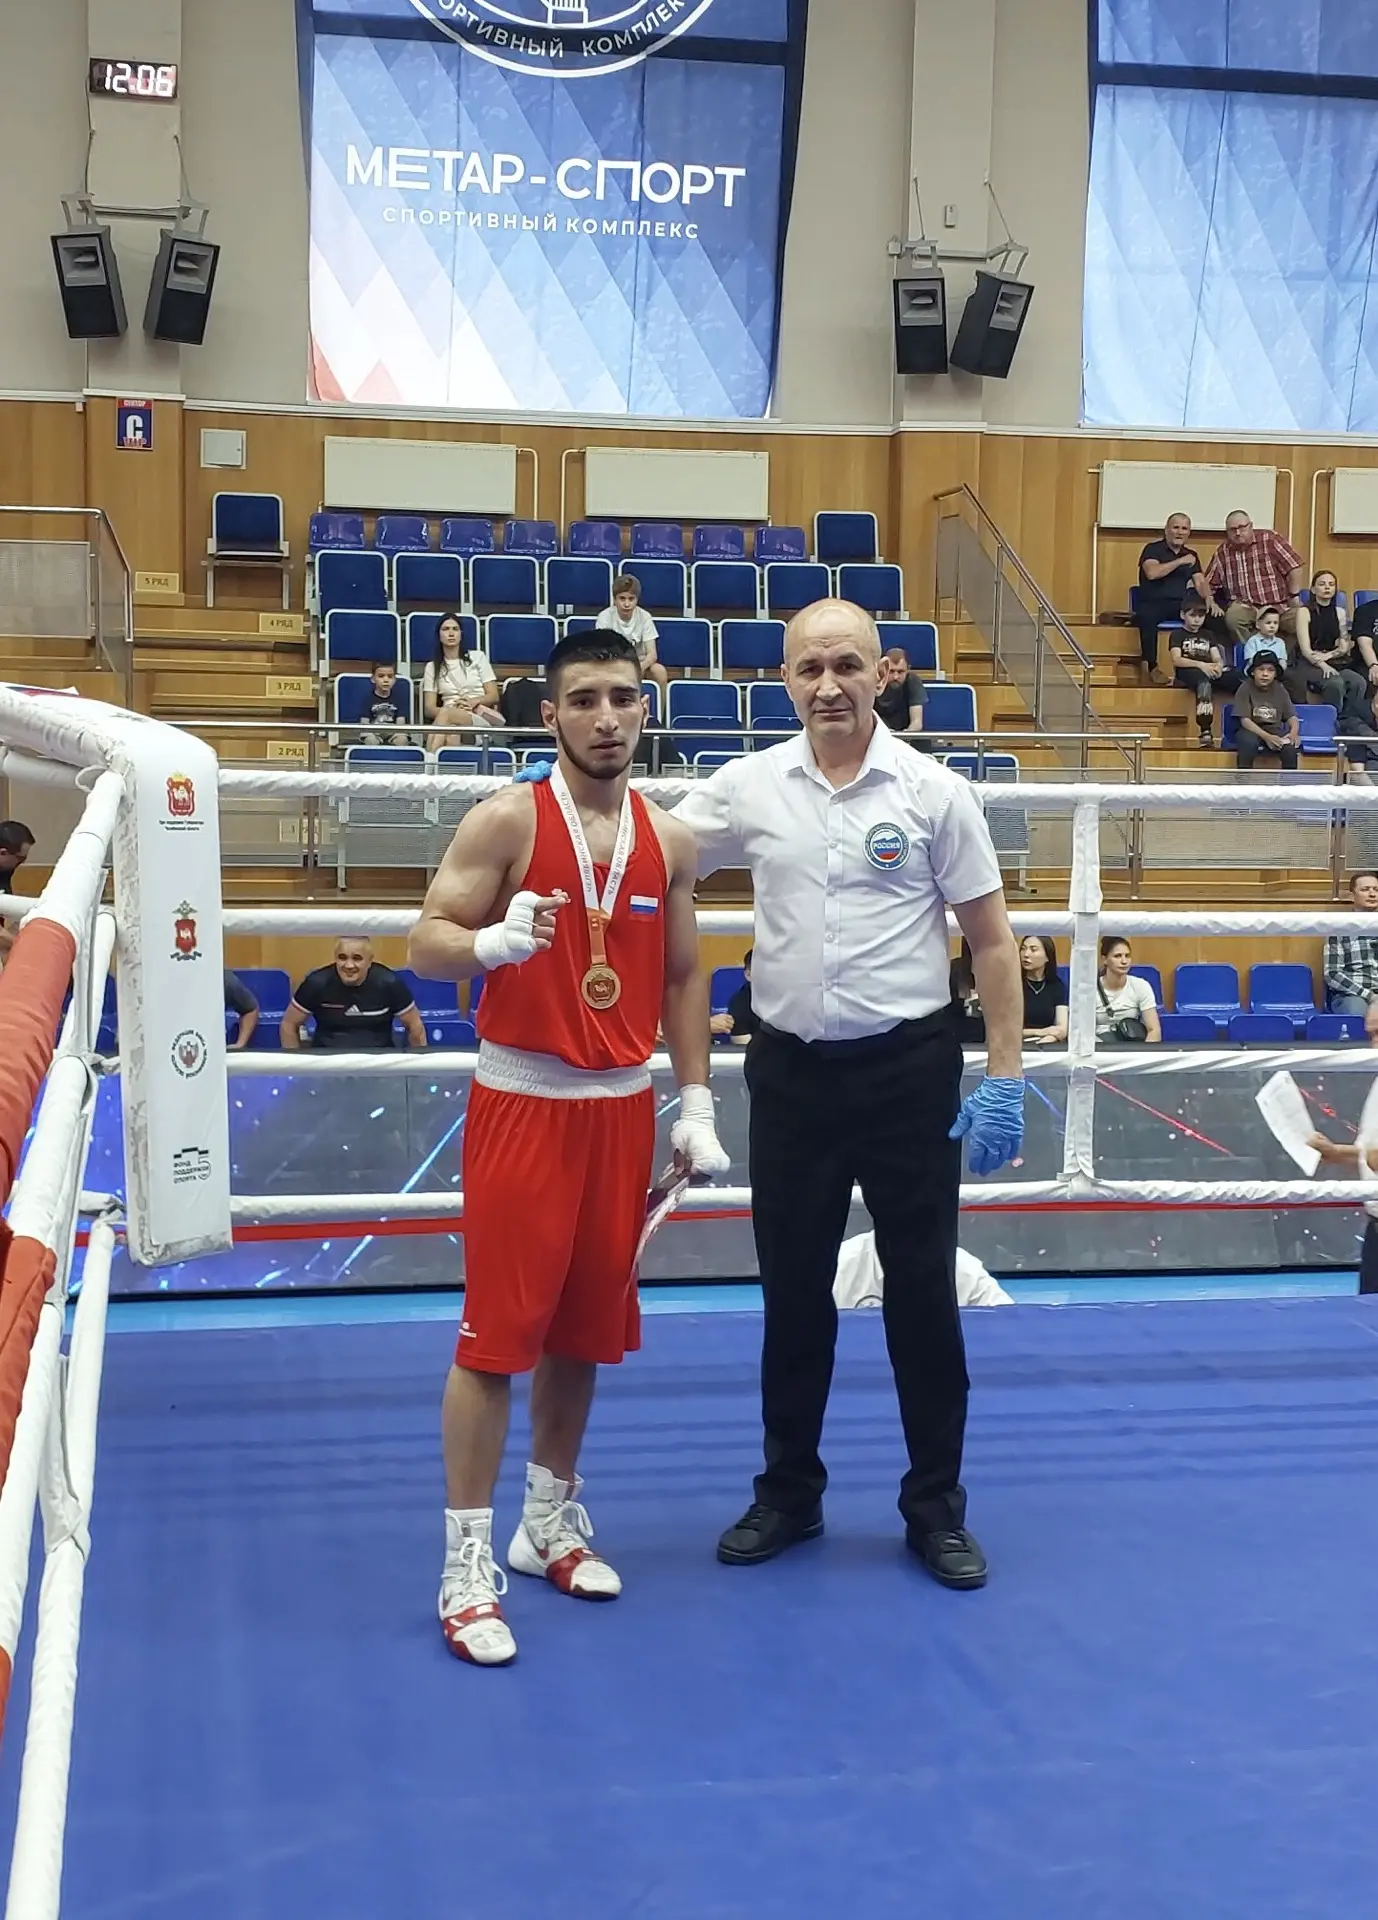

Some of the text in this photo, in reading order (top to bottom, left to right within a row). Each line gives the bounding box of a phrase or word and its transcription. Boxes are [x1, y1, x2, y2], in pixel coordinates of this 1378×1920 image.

[382, 206, 700, 239] СПОРТИВНЫЙ КОМПЛЕКС
[151, 577, 169, 587] РЯД
[276, 619, 294, 628] РЯД
[283, 682, 301, 691] РЯД
[278, 747, 305, 757] 2 РЯД
